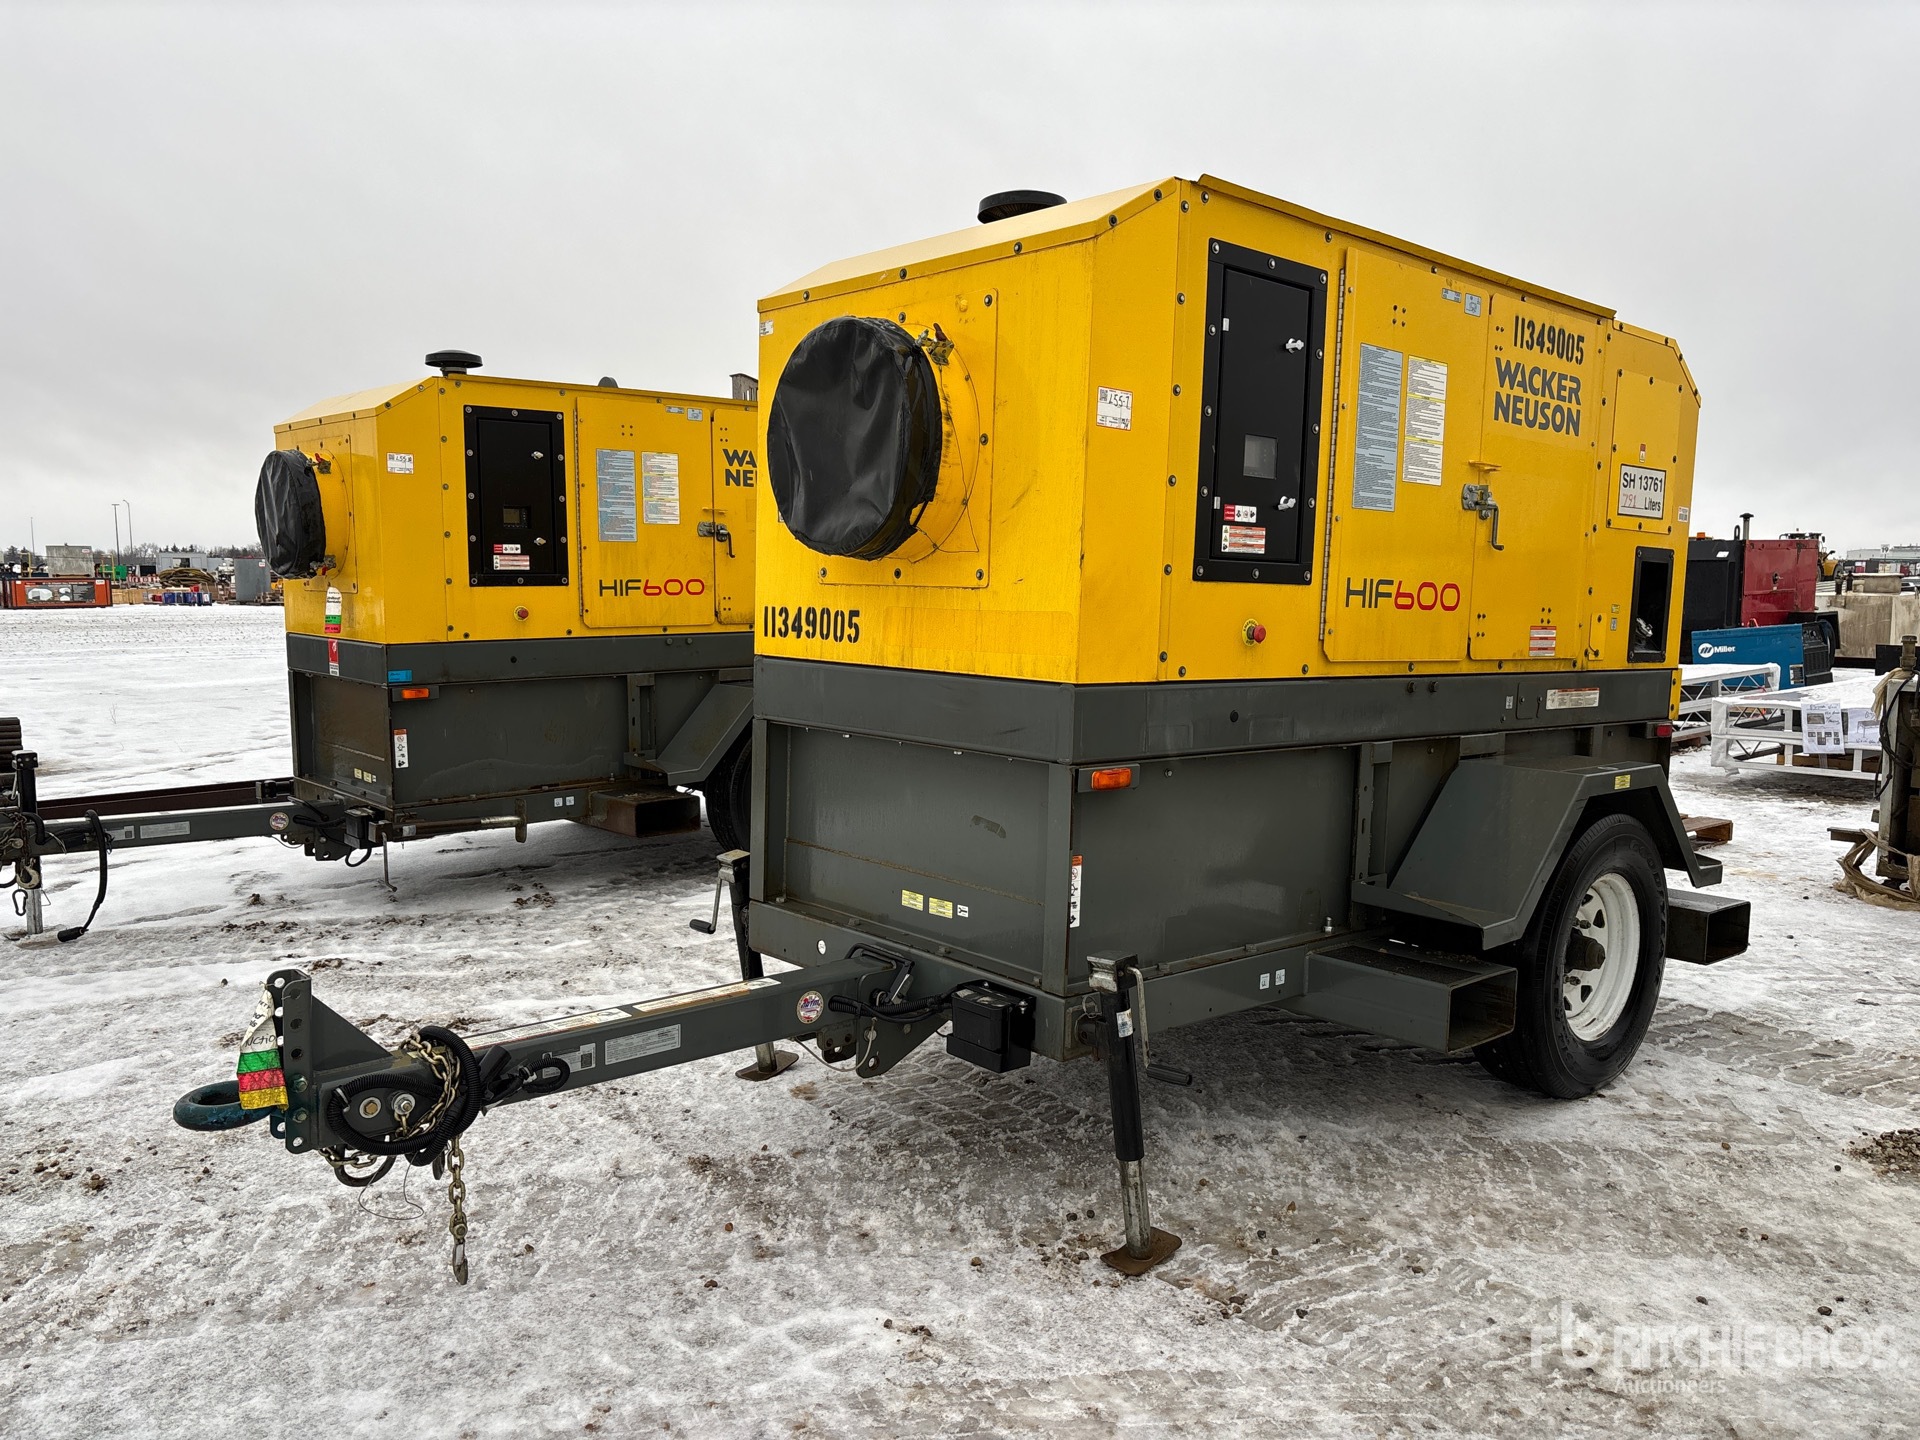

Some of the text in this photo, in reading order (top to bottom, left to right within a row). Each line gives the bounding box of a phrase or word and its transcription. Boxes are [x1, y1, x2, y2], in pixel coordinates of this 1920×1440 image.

[1513, 315, 1585, 365] 11349005
[1495, 356, 1581, 406] WACKER
[1493, 391, 1581, 437] NEUSON
[1622, 472, 1663, 493] SH 13761
[1643, 496, 1662, 512] Liters
[599, 578, 705, 597] HIF600
[1345, 576, 1461, 612] HIF600
[763, 605, 860, 644] 11349005
[1713, 645, 1736, 654] Miller
